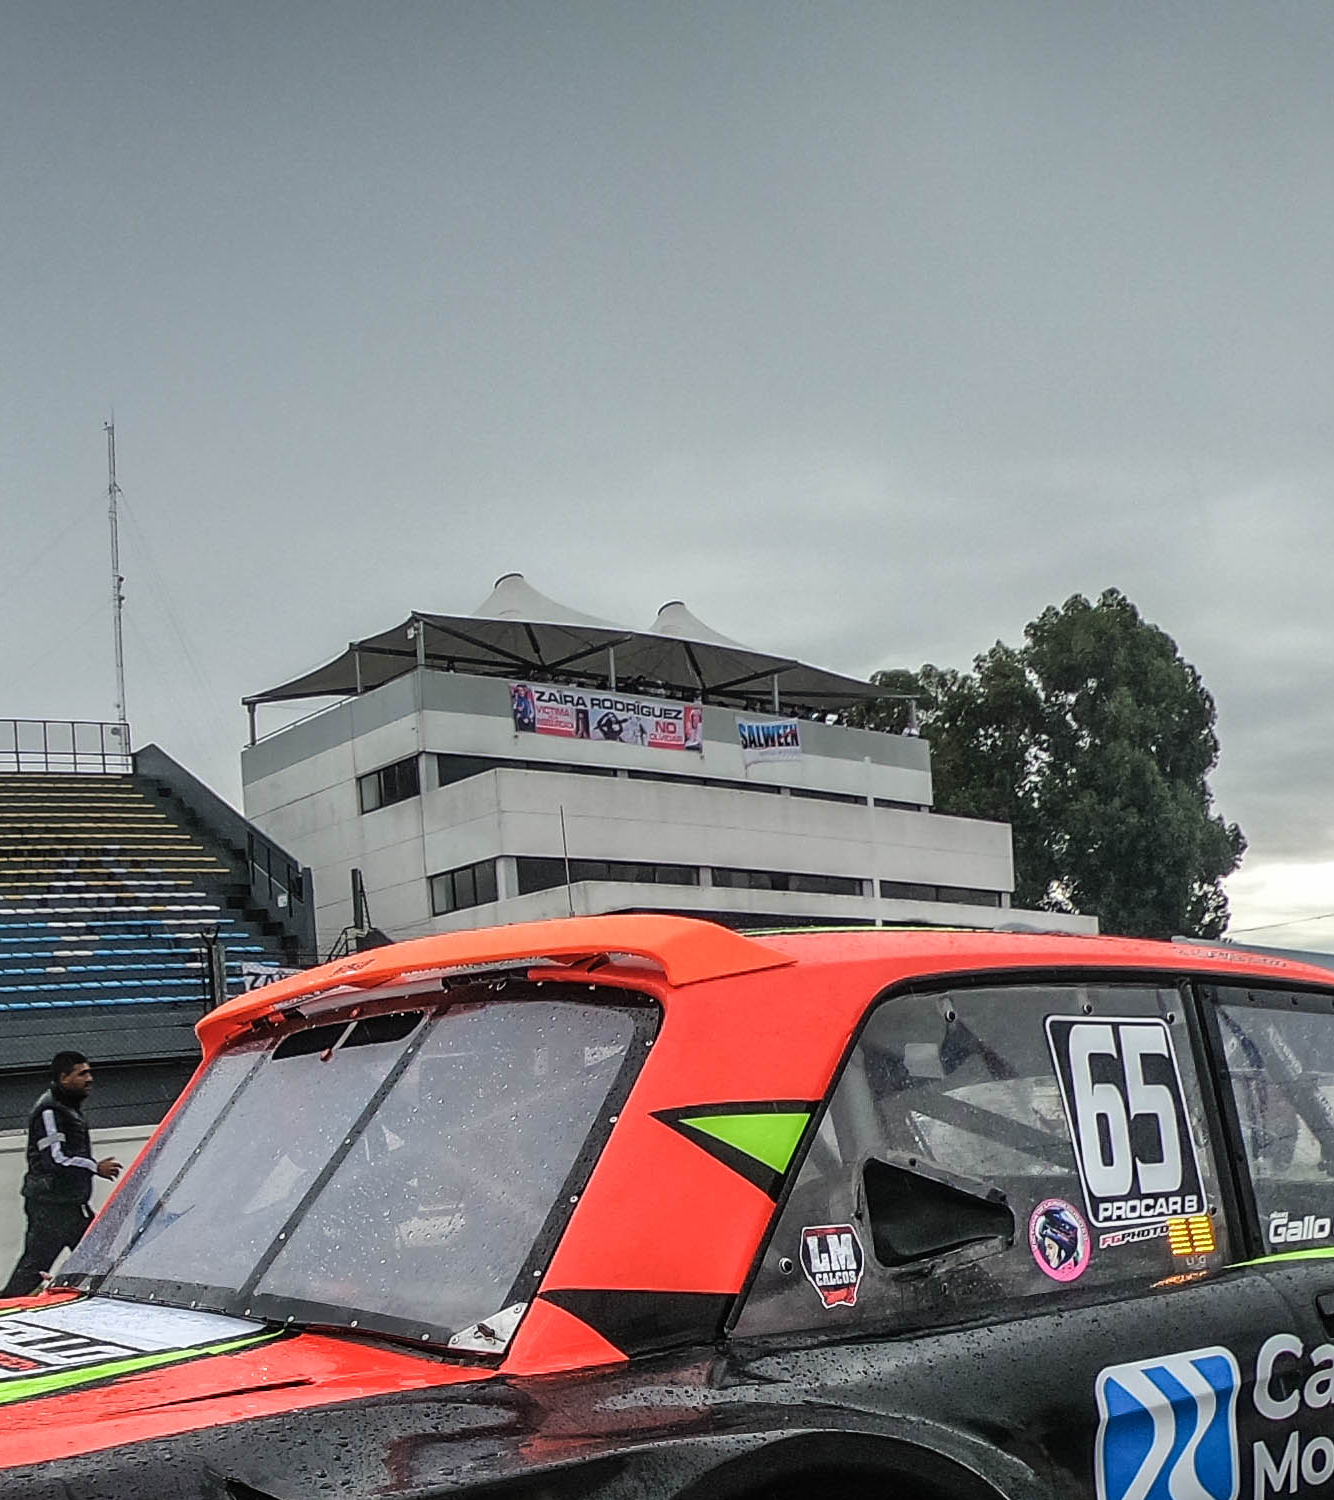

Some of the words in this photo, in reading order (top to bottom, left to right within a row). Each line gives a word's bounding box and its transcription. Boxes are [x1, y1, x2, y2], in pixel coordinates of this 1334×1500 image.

[655, 720, 677, 734] NO
[1069, 1024, 1182, 1197] 65
[1098, 1197, 1181, 1221] PROCAR
[1183, 1195, 1198, 1213] B
[1269, 1216, 1330, 1243] Gallo
[807, 1233, 857, 1273] LM
[816, 1270, 857, 1286] CALCOS
